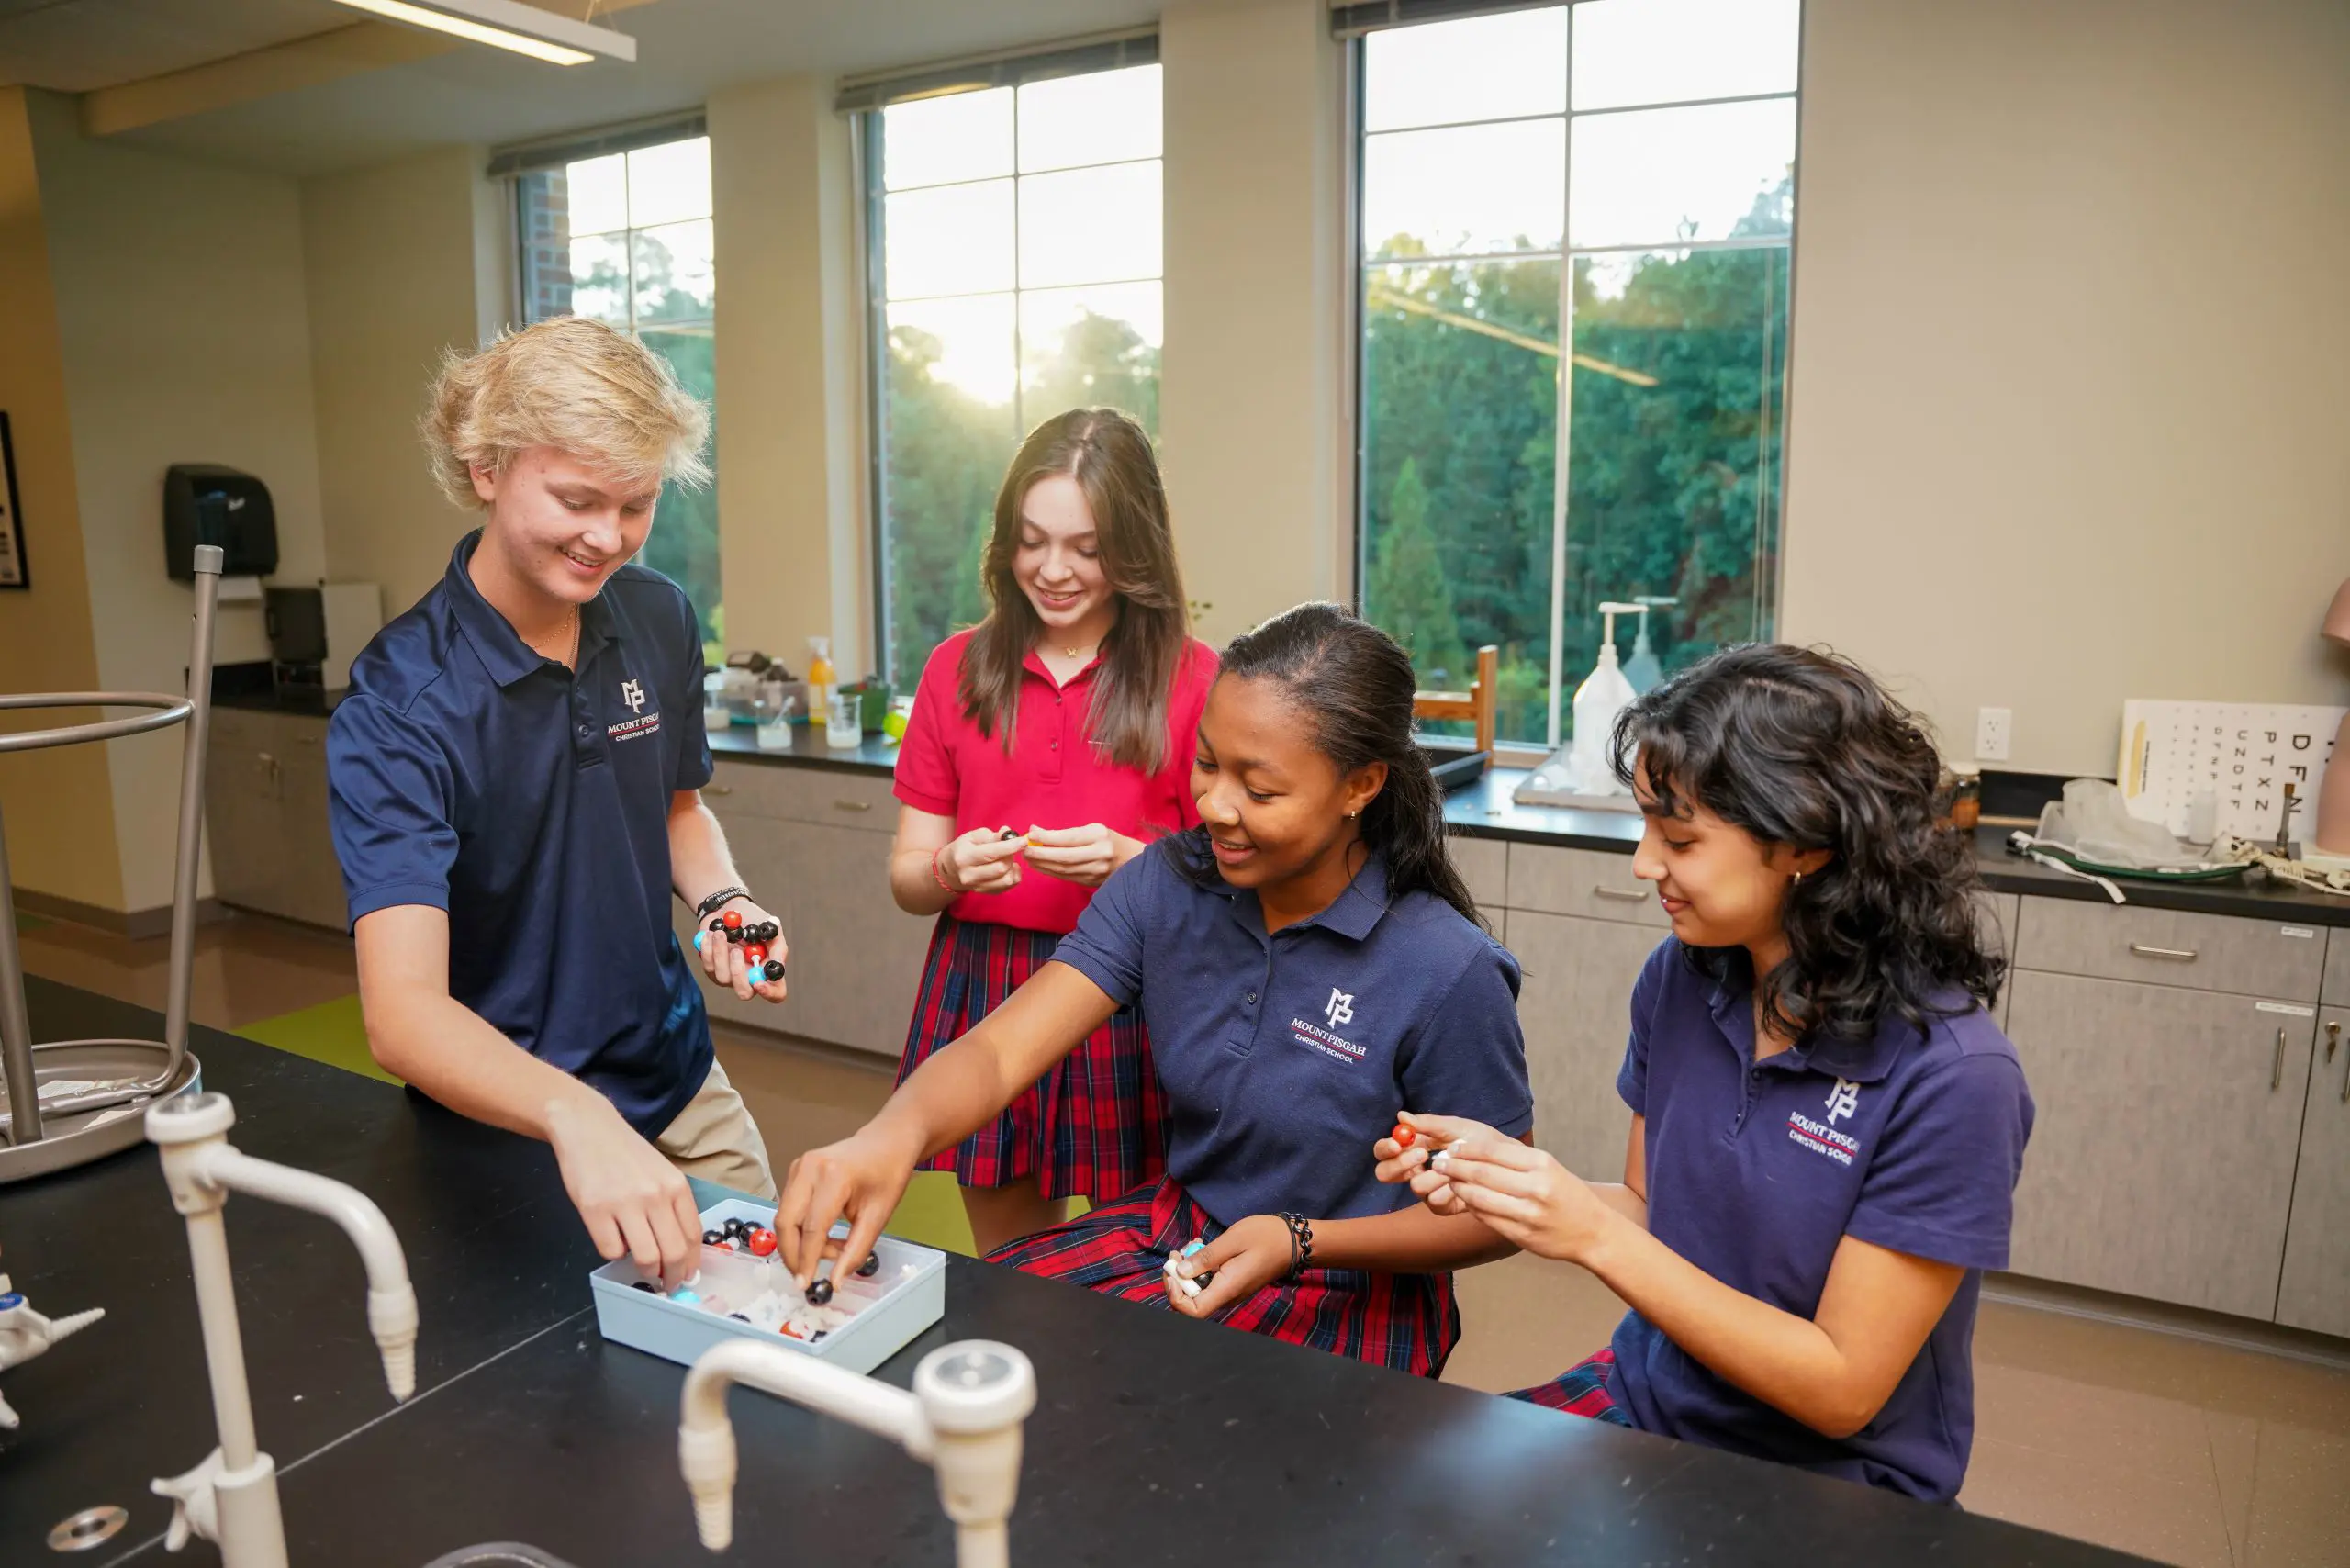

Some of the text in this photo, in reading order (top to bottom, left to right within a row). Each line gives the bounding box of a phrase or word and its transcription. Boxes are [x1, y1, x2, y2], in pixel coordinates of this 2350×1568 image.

[608, 719, 640, 734] MOUNT
[616, 730, 644, 742] CHRISTIAN
[1291, 1017, 1367, 1057] MOUNT PISGAH
[1294, 1033, 1353, 1064] CHRISTIAN SCHOOL
[1789, 1111, 1828, 1137] MOUNT
